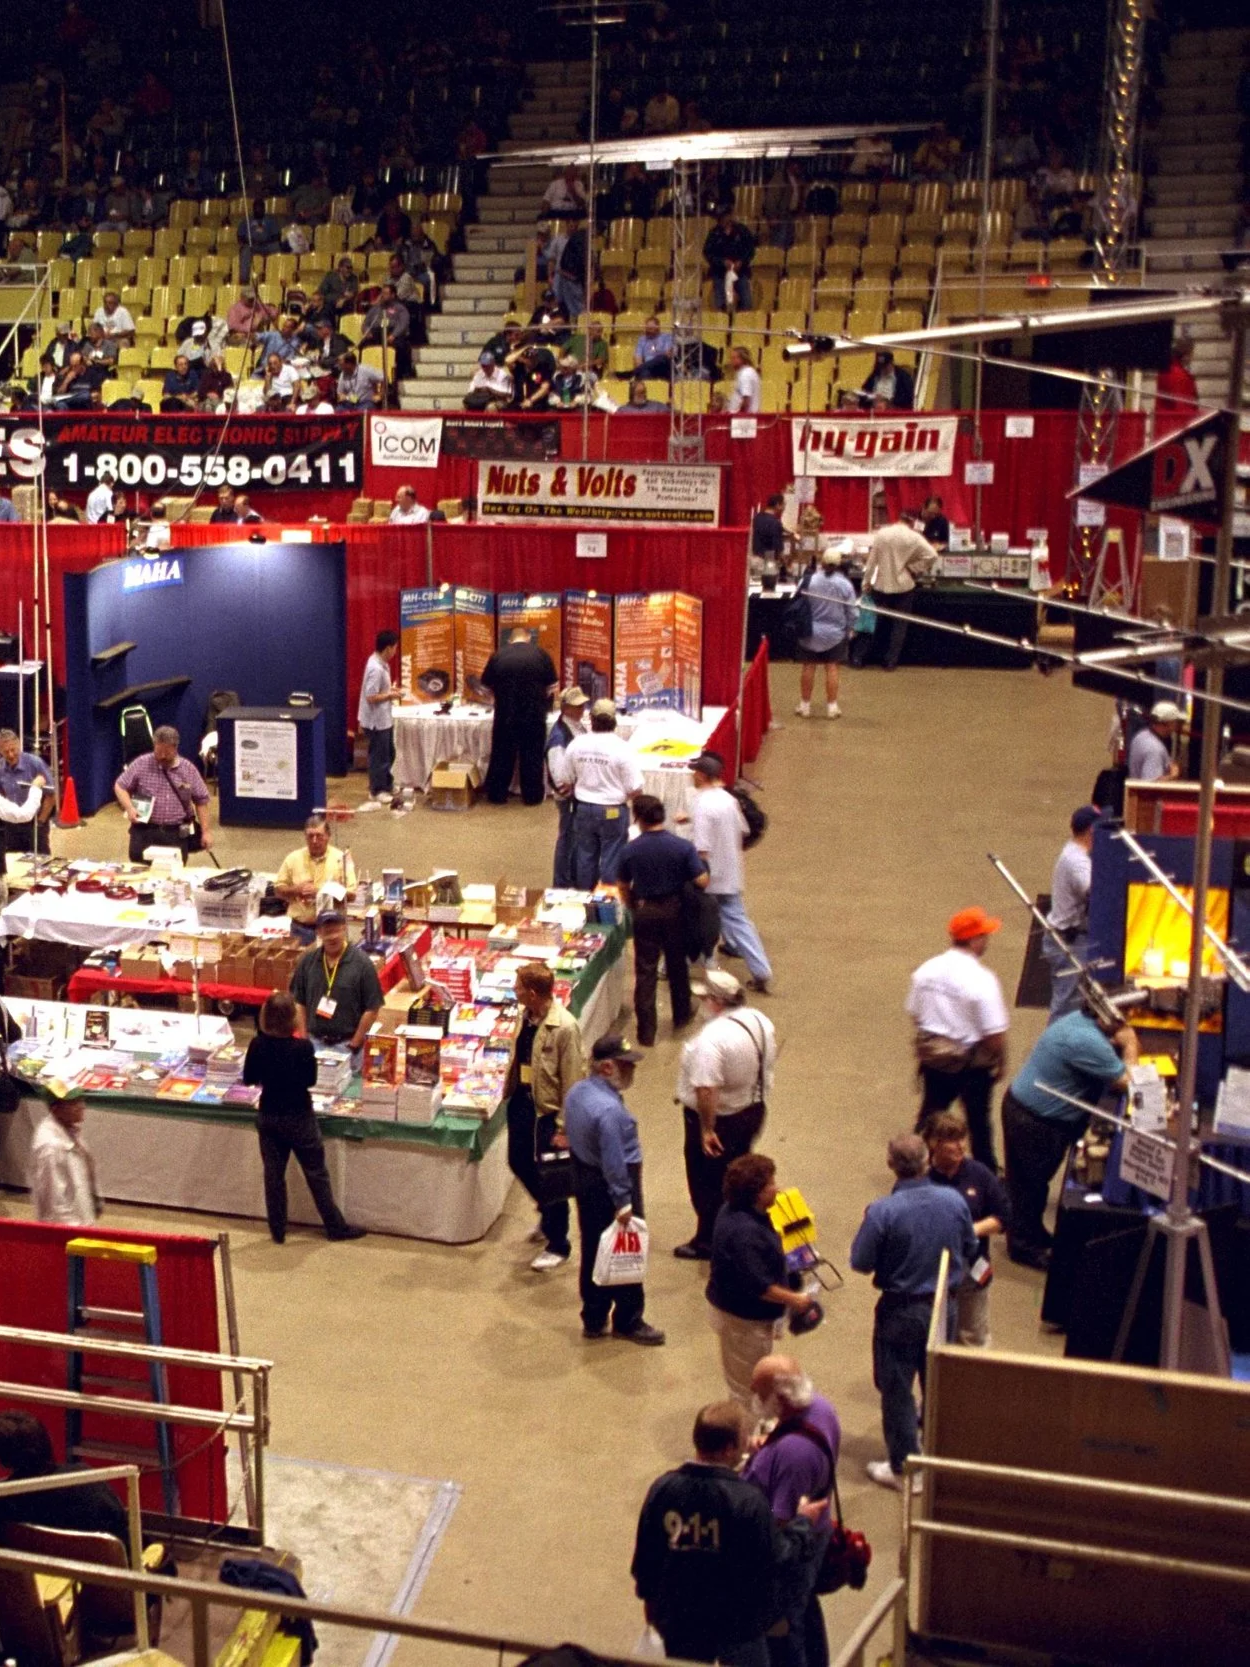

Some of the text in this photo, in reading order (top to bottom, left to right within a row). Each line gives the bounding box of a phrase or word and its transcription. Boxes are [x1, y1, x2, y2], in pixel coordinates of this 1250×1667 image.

[57, 424, 360, 445] AMATEUR ELECTRONIC SUPPLY
[379, 435, 436, 454] ICOM
[62, 452, 356, 486] 1-800-558-0411
[486, 465, 637, 498] Nuts & Volts
[1153, 434, 1218, 499] DX
